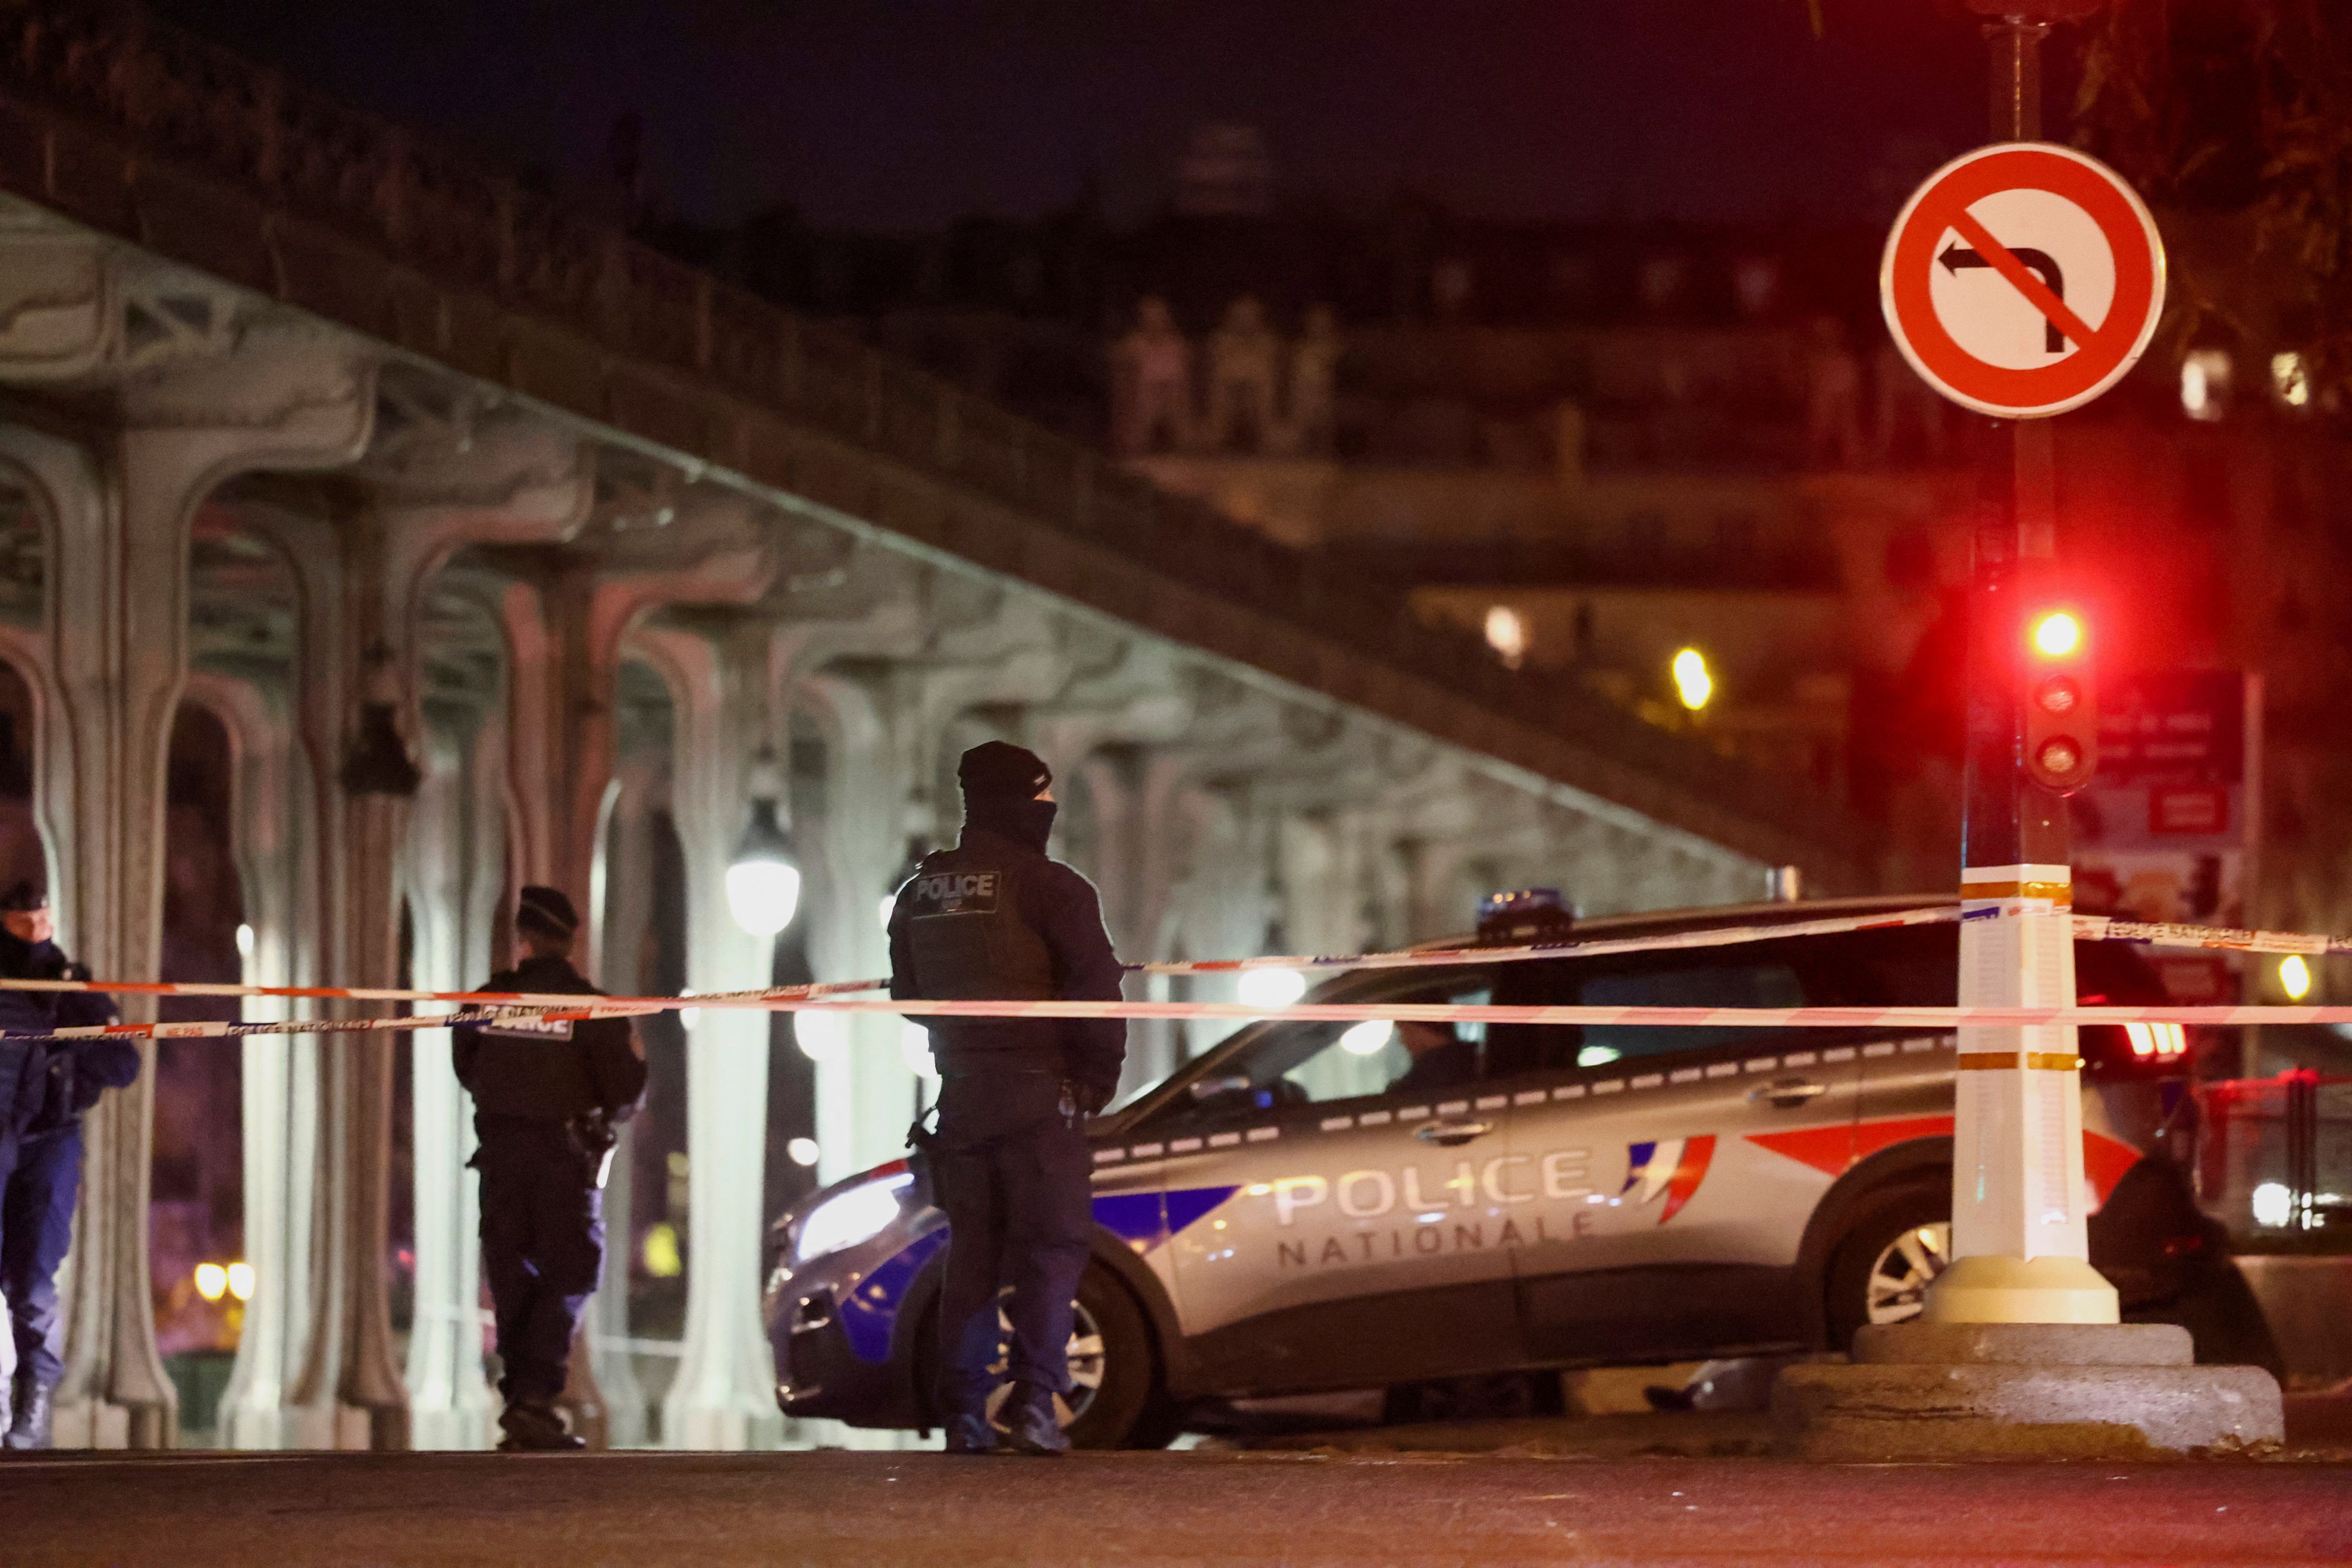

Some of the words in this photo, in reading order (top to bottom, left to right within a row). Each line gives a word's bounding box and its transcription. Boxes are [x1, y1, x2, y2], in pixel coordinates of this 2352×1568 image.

[914, 874, 994, 902] POLICE
[1274, 1150, 1592, 1225] POLICE
[1278, 1212, 1592, 1268] NATIONALE
